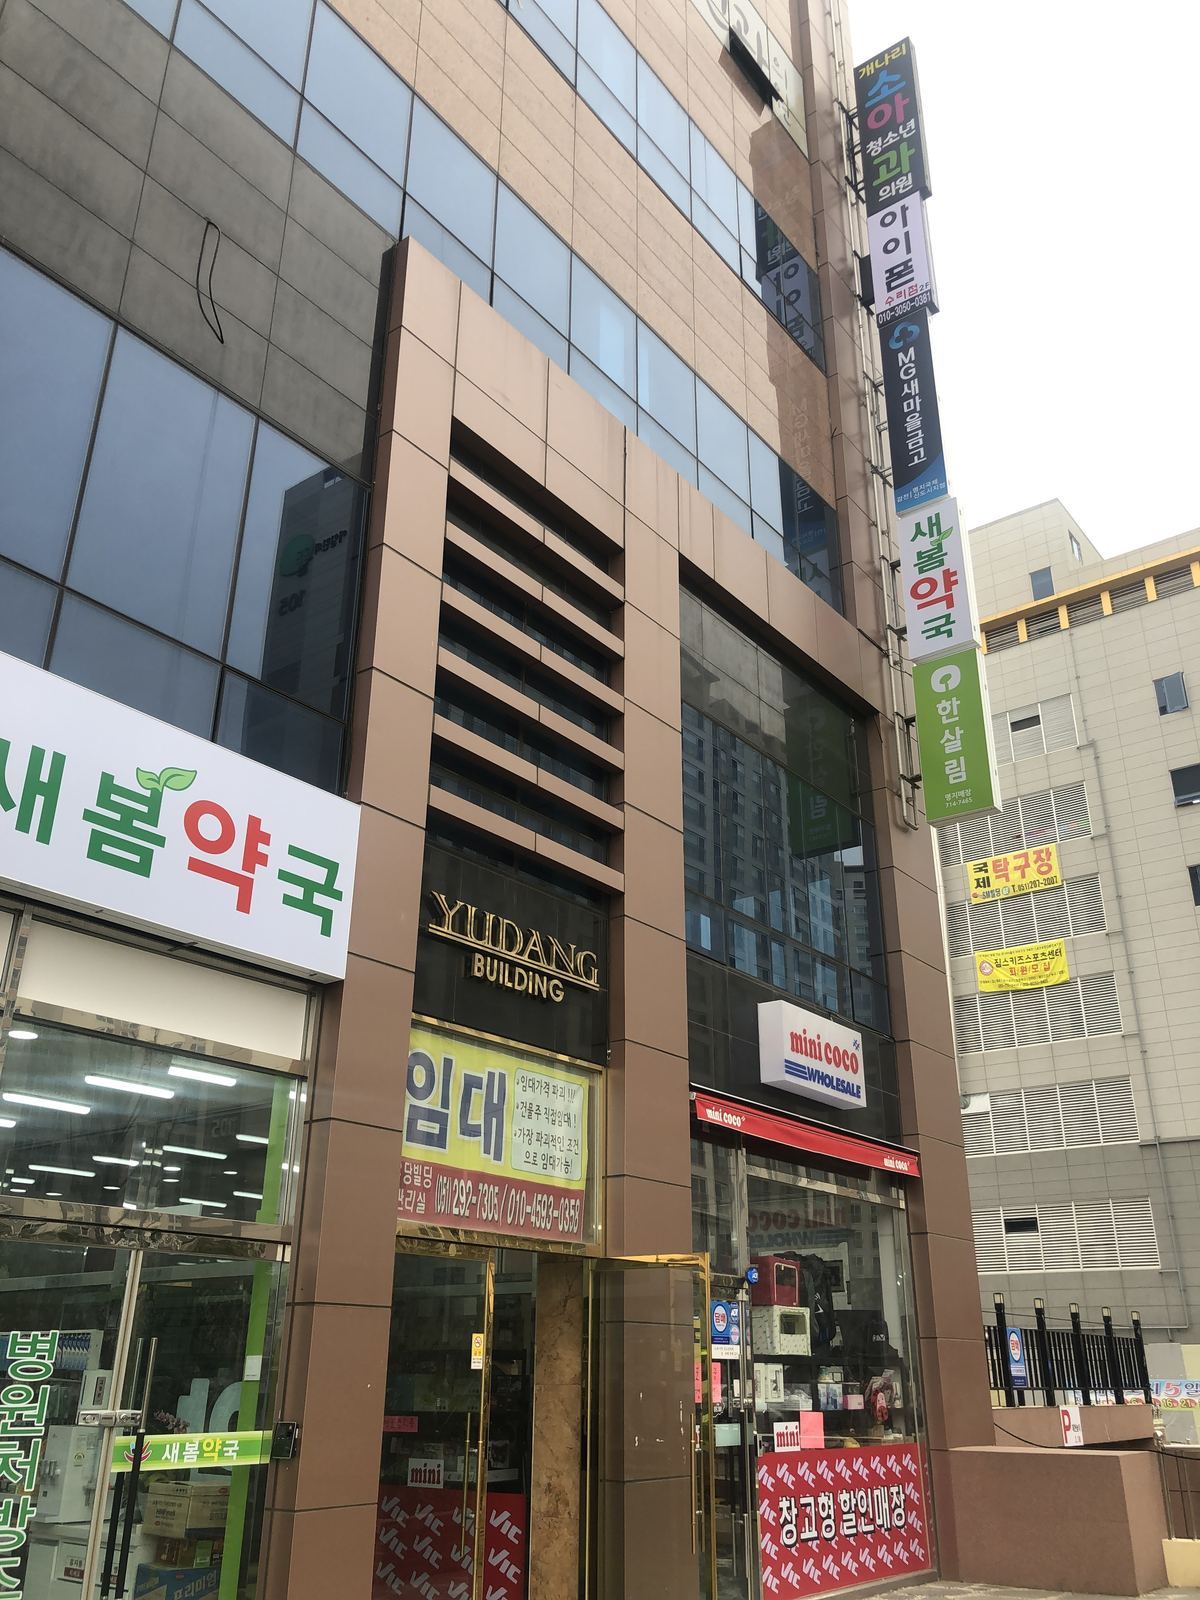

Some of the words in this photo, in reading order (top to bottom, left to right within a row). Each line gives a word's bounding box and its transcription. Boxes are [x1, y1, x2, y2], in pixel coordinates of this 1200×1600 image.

[859, 43, 906, 79] 개나리
[866, 119, 915, 156] 청소년
[873, 142, 915, 186] 과
[879, 173, 913, 202] 의원
[879, 205, 914, 292] 아이폰
[885, 284, 918, 306] 수리점
[910, 512, 959, 640] 새봄약국
[936, 696, 968, 785] 한살림
[0, 737, 343, 938] 새봄약국
[992, 848, 1053, 882] 탁구장
[430, 890, 598, 984] YUDANG
[472, 953, 565, 1003] BUILDING
[789, 1029, 822, 1061] mini
[825, 1043, 859, 1075] coco
[520, 1075, 550, 1098] 임대가격
[807, 1066, 861, 1099] WHOLESALE
[405, 1051, 506, 1162] 임대
[520, 1101, 541, 1120] 건물주
[706, 1107, 722, 1121] mini
[723, 1112, 741, 1127] coco
[518, 1128, 533, 1145] 가장
[536, 1131, 564, 1152] 파괴적인
[567, 1139, 579, 1155] 조건
[524, 1150, 538, 1166] 으로
[400, 1161, 433, 1189] 당빌딩
[776, 1425, 800, 1448] mini
[1061, 1409, 1071, 1444] P
[162, 1437, 240, 1463] 새봄약국
[410, 1463, 441, 1484] mini
[779, 1491, 836, 1546] 창고형
[839, 1484, 905, 1536] 할인매장
